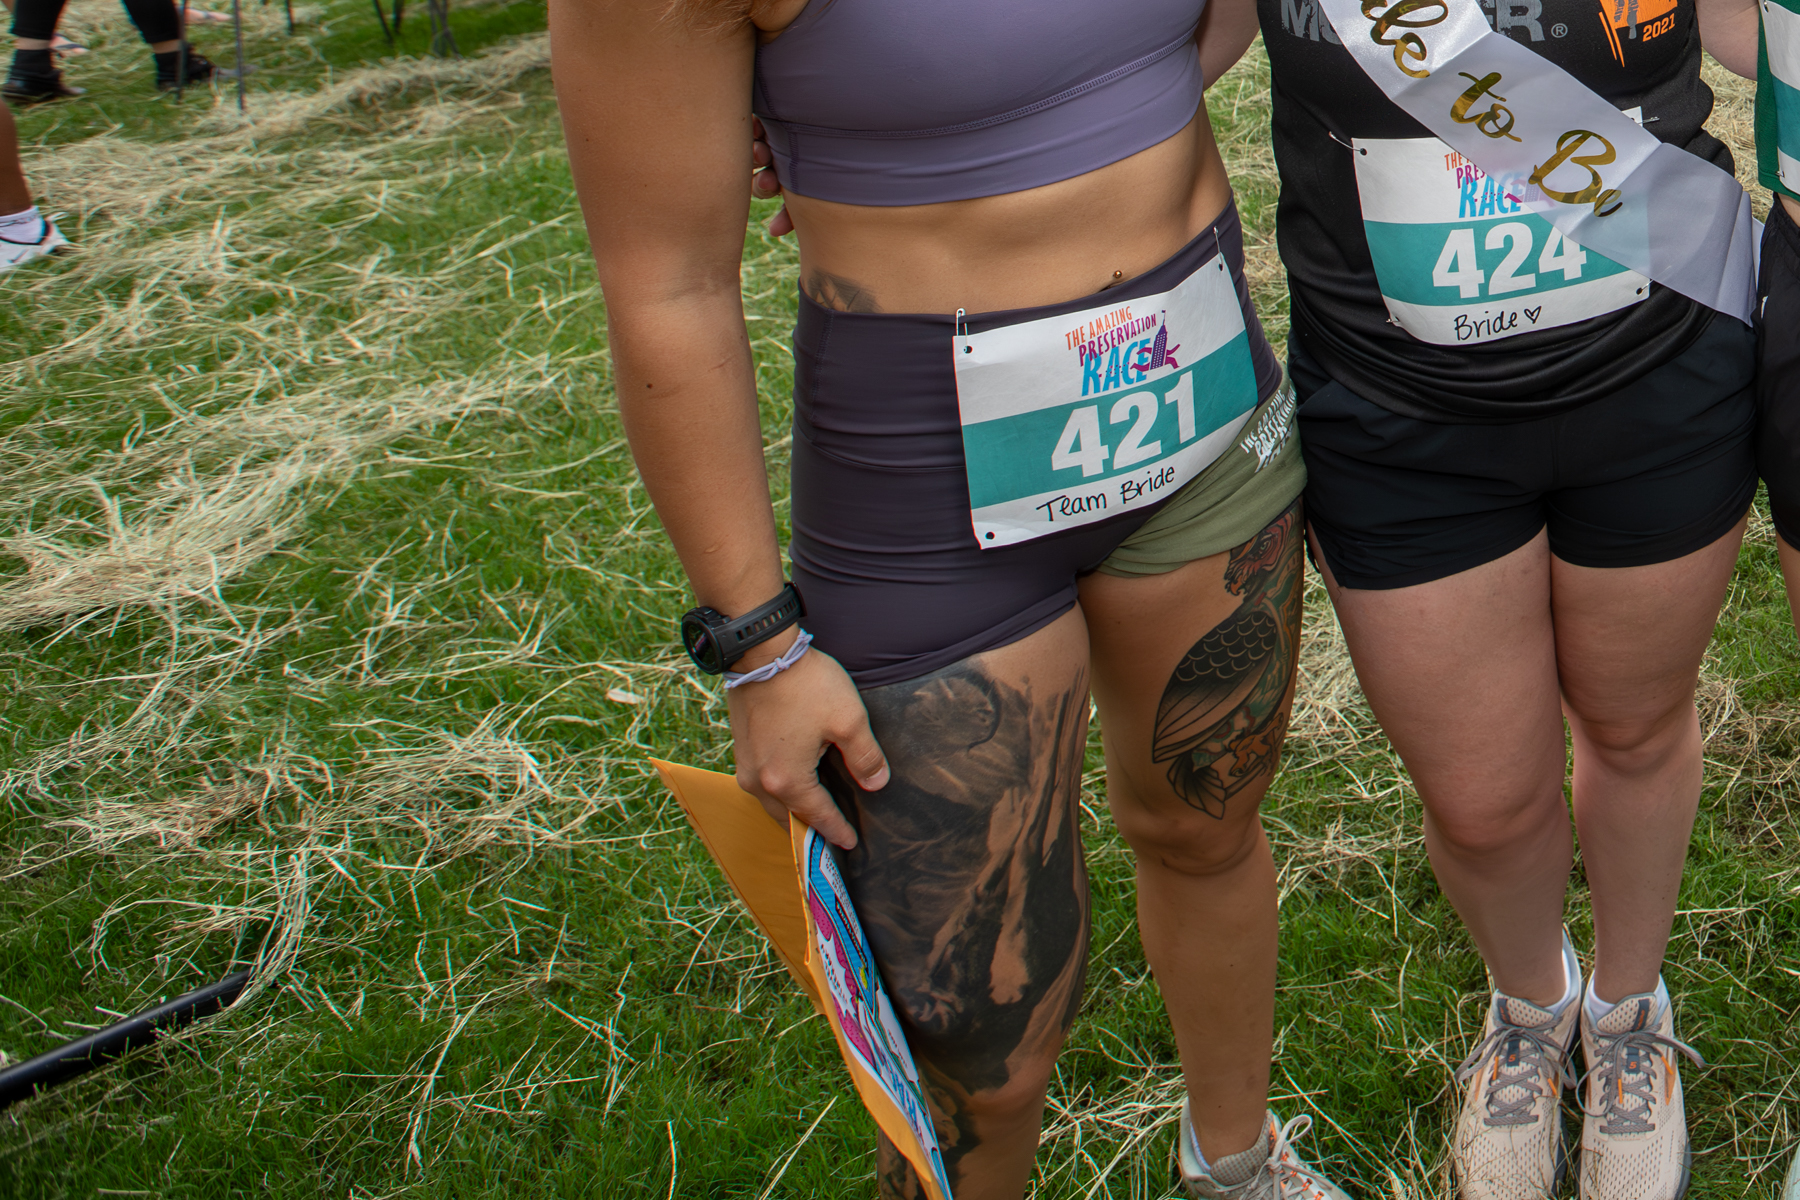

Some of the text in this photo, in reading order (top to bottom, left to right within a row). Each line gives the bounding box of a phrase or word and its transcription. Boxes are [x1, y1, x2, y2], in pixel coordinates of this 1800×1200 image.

[1642, 15, 1676, 43] 2021
[1444, 151, 1463, 171] THE
[1449, 71, 1523, 143] to
[1527, 129, 1625, 218] Be
[1432, 221, 1587, 299] 424
[1065, 306, 1133, 351] THE AMAZING
[1078, 313, 1157, 367] PRESERVATION
[1453, 310, 1518, 341] Bride
[1081, 337, 1151, 397] RACE
[1051, 370, 1197, 478] 421
[1036, 465, 1176, 522] Team Bride
